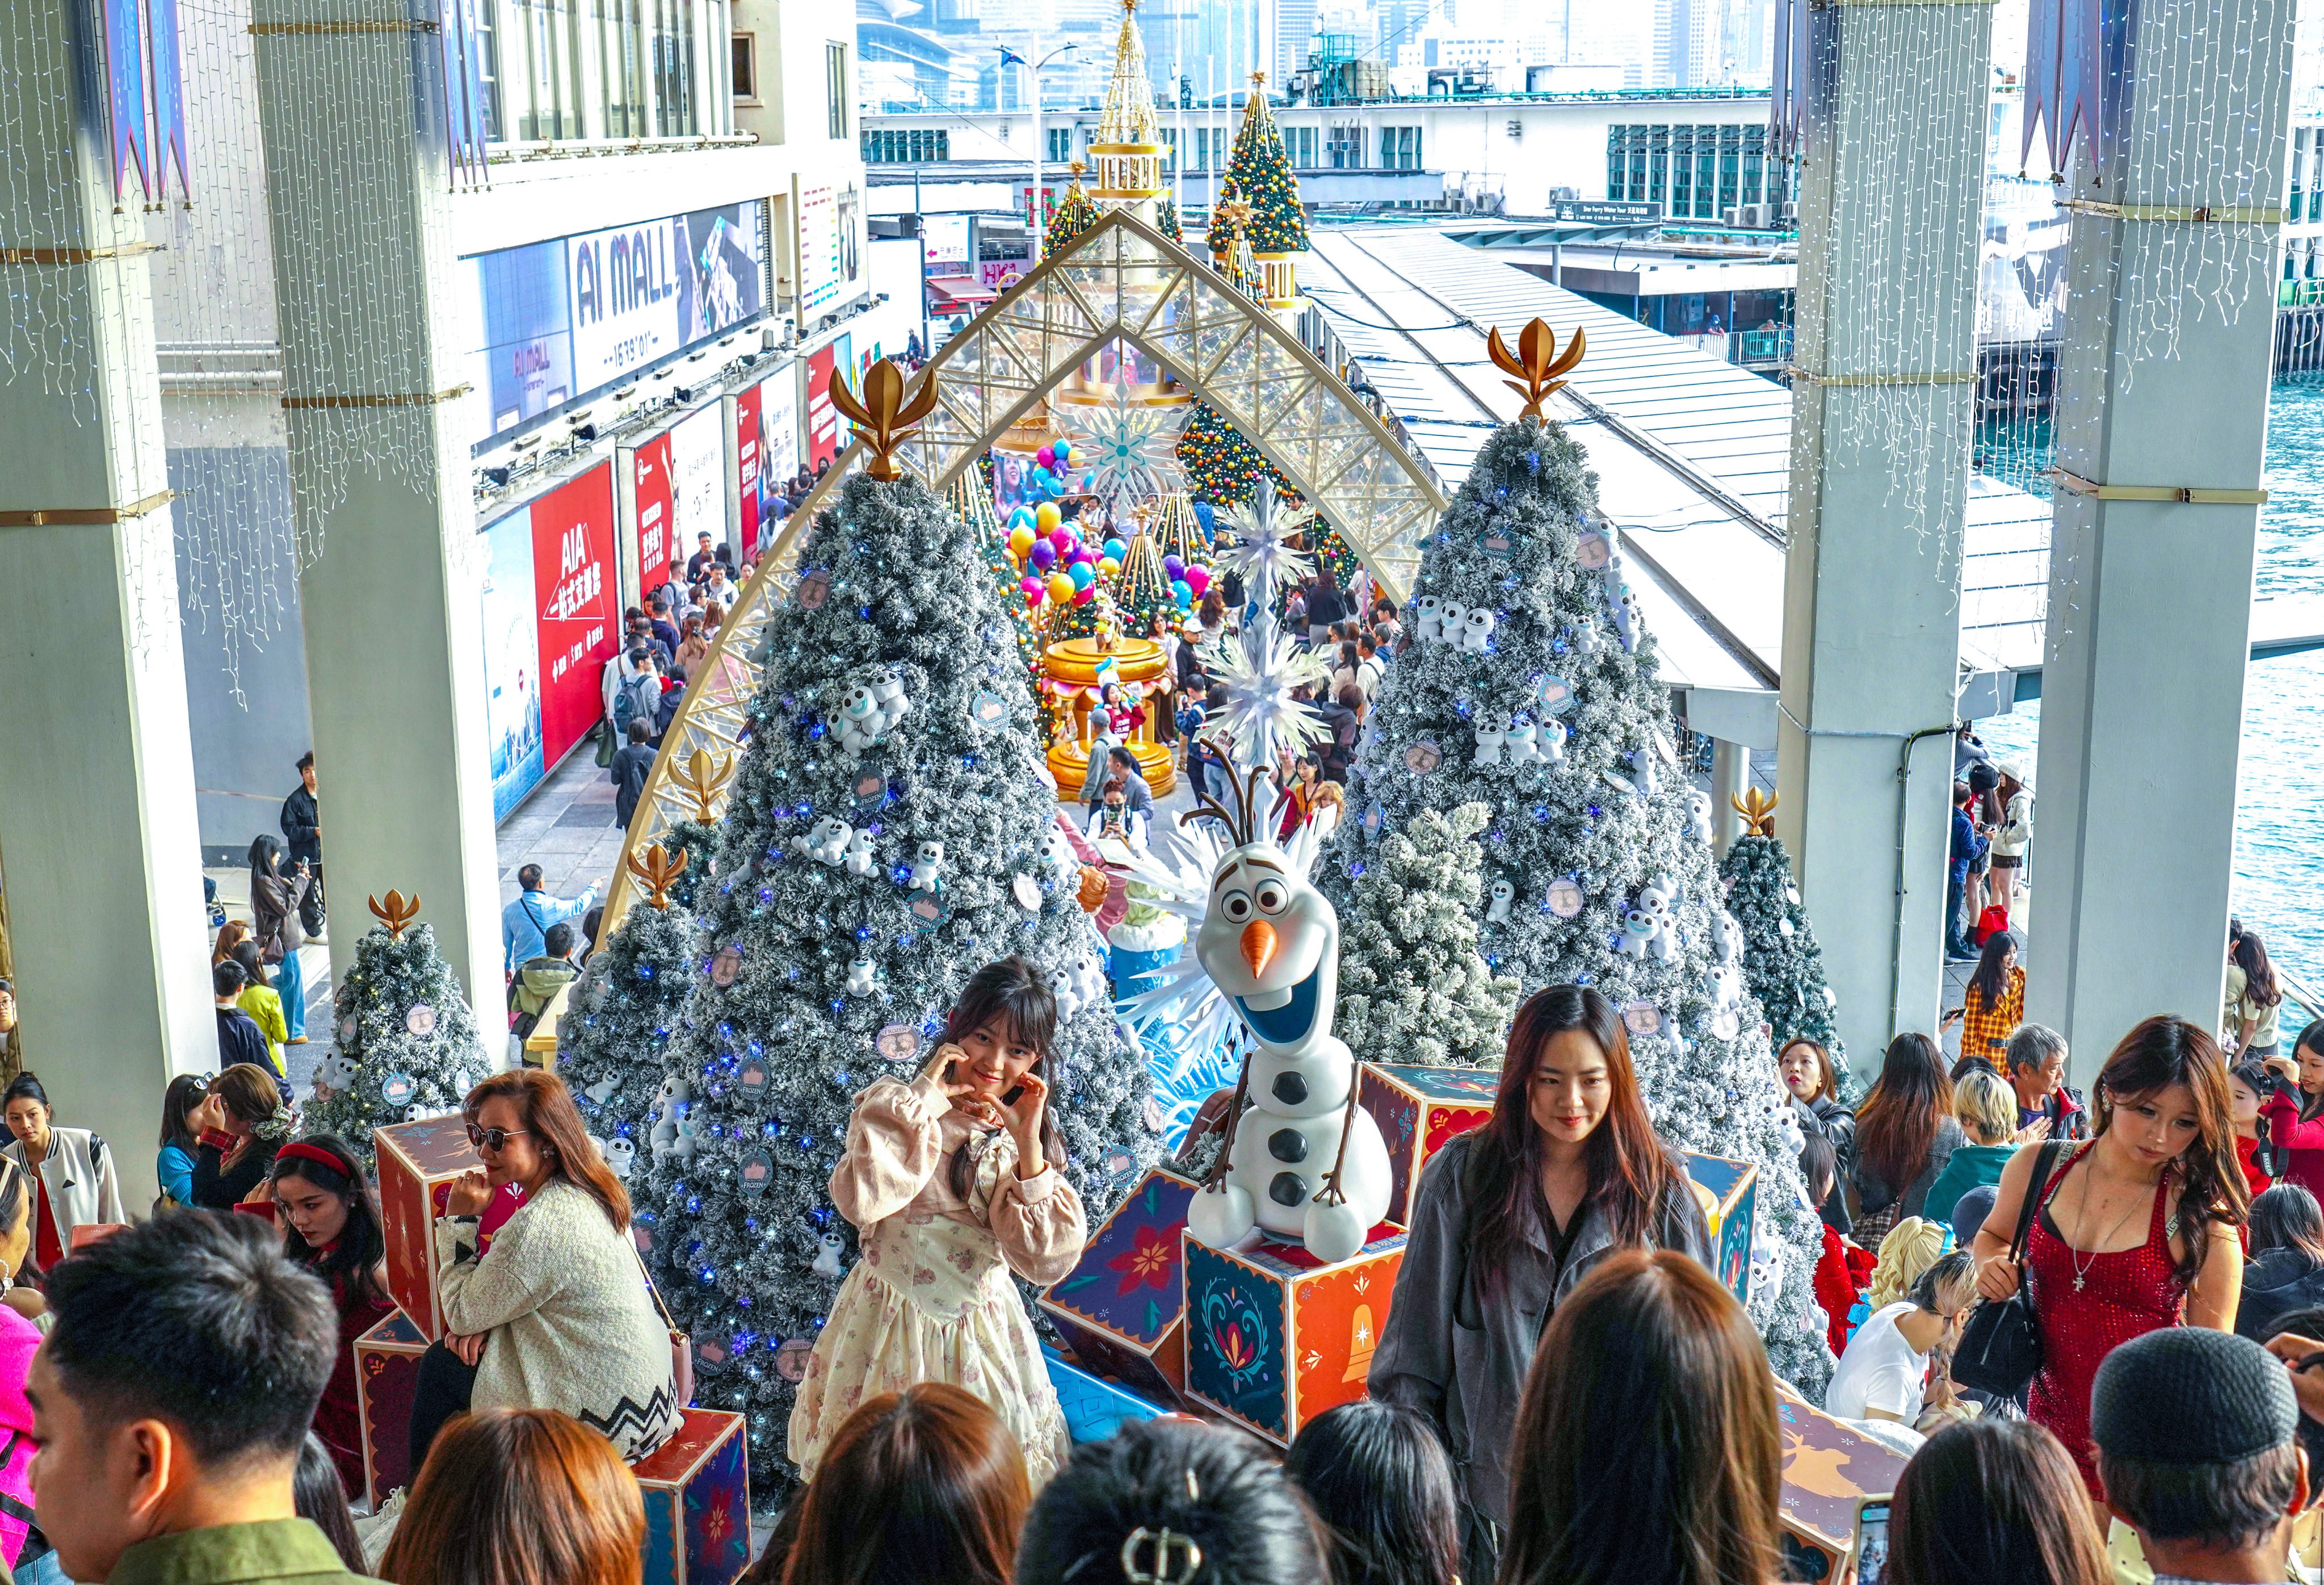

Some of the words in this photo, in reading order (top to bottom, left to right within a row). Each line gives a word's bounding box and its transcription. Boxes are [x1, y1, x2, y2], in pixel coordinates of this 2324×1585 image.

[577, 240, 603, 328] AI
[610, 225, 672, 317] MALL
[561, 523, 586, 580] AIA
[1551, 698, 1570, 711] FROZEN
[987, 717, 1007, 728] FROZEN
[861, 793, 881, 806] FROZEN
[909, 915, 932, 929] FROZEN
[1112, 1169, 1134, 1185] FROZEN
[696, 1357, 718, 1372] FROZEN
